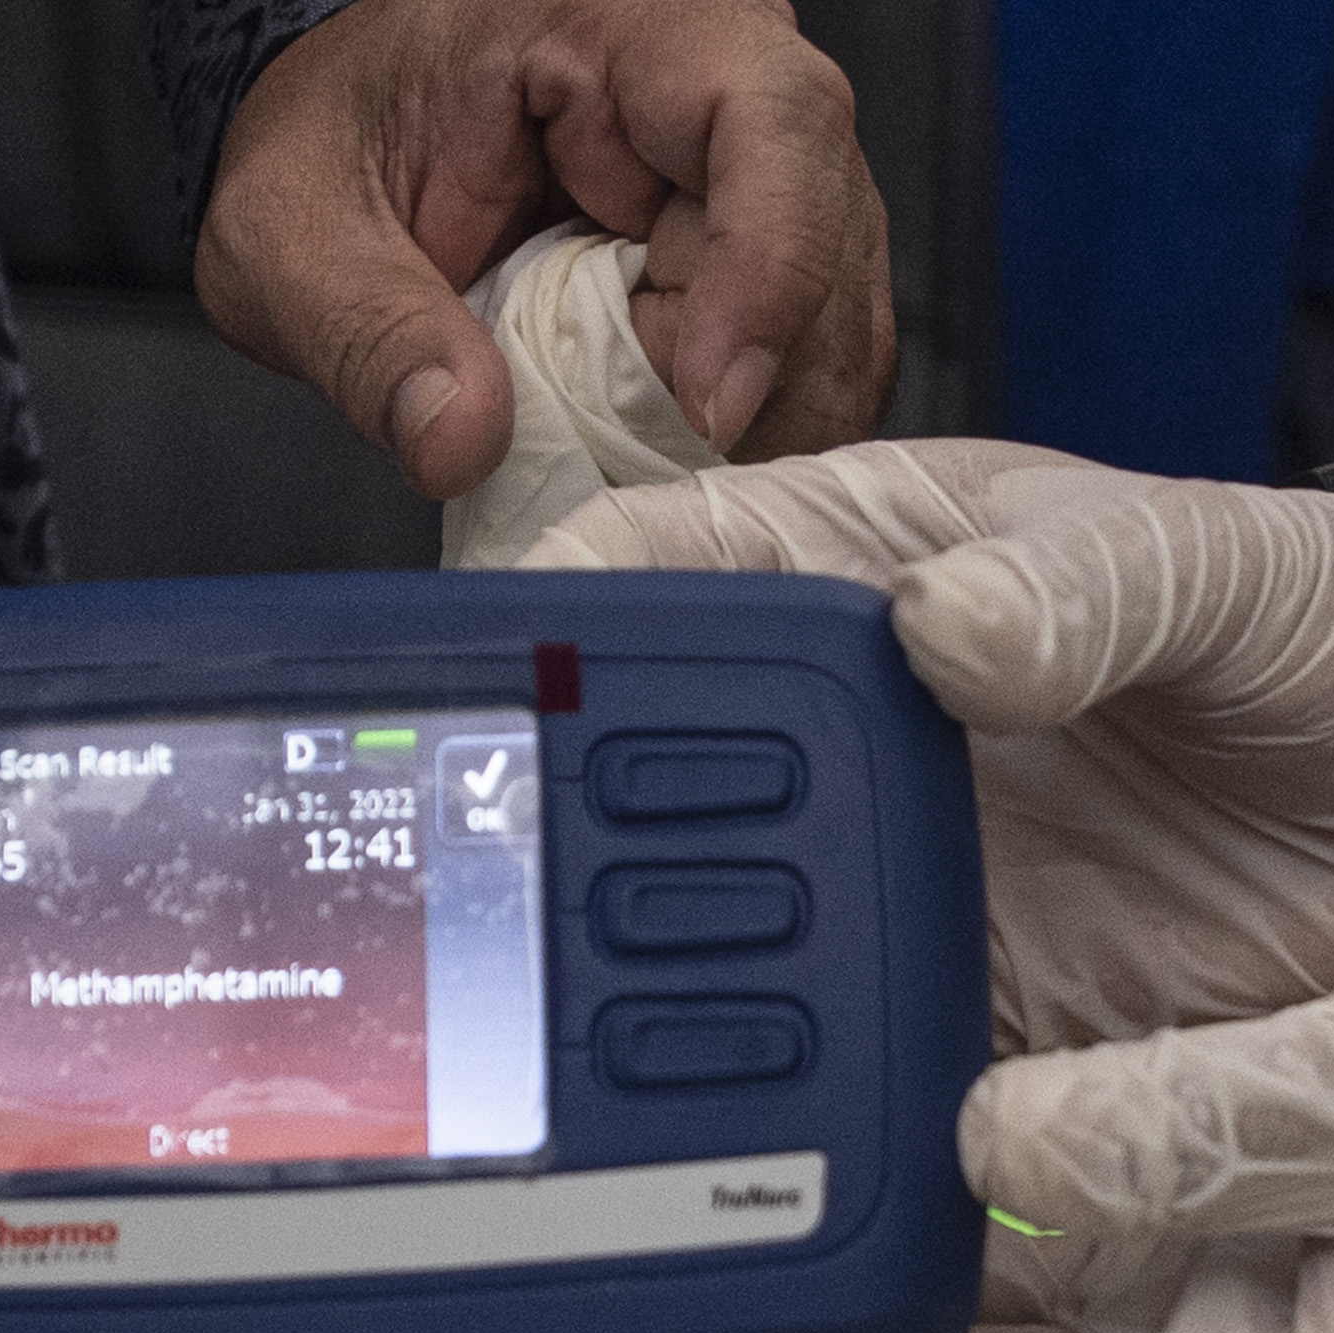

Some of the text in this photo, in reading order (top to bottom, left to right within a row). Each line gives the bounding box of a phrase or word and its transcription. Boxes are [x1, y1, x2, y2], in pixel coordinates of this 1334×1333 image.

[78, 742, 173, 777] Result
[348, 787, 415, 820] 2022
[303, 826, 416, 872] 12:41
[29, 961, 344, 1009] Methamphetamine
[149, 1123, 230, 1158] Dect
